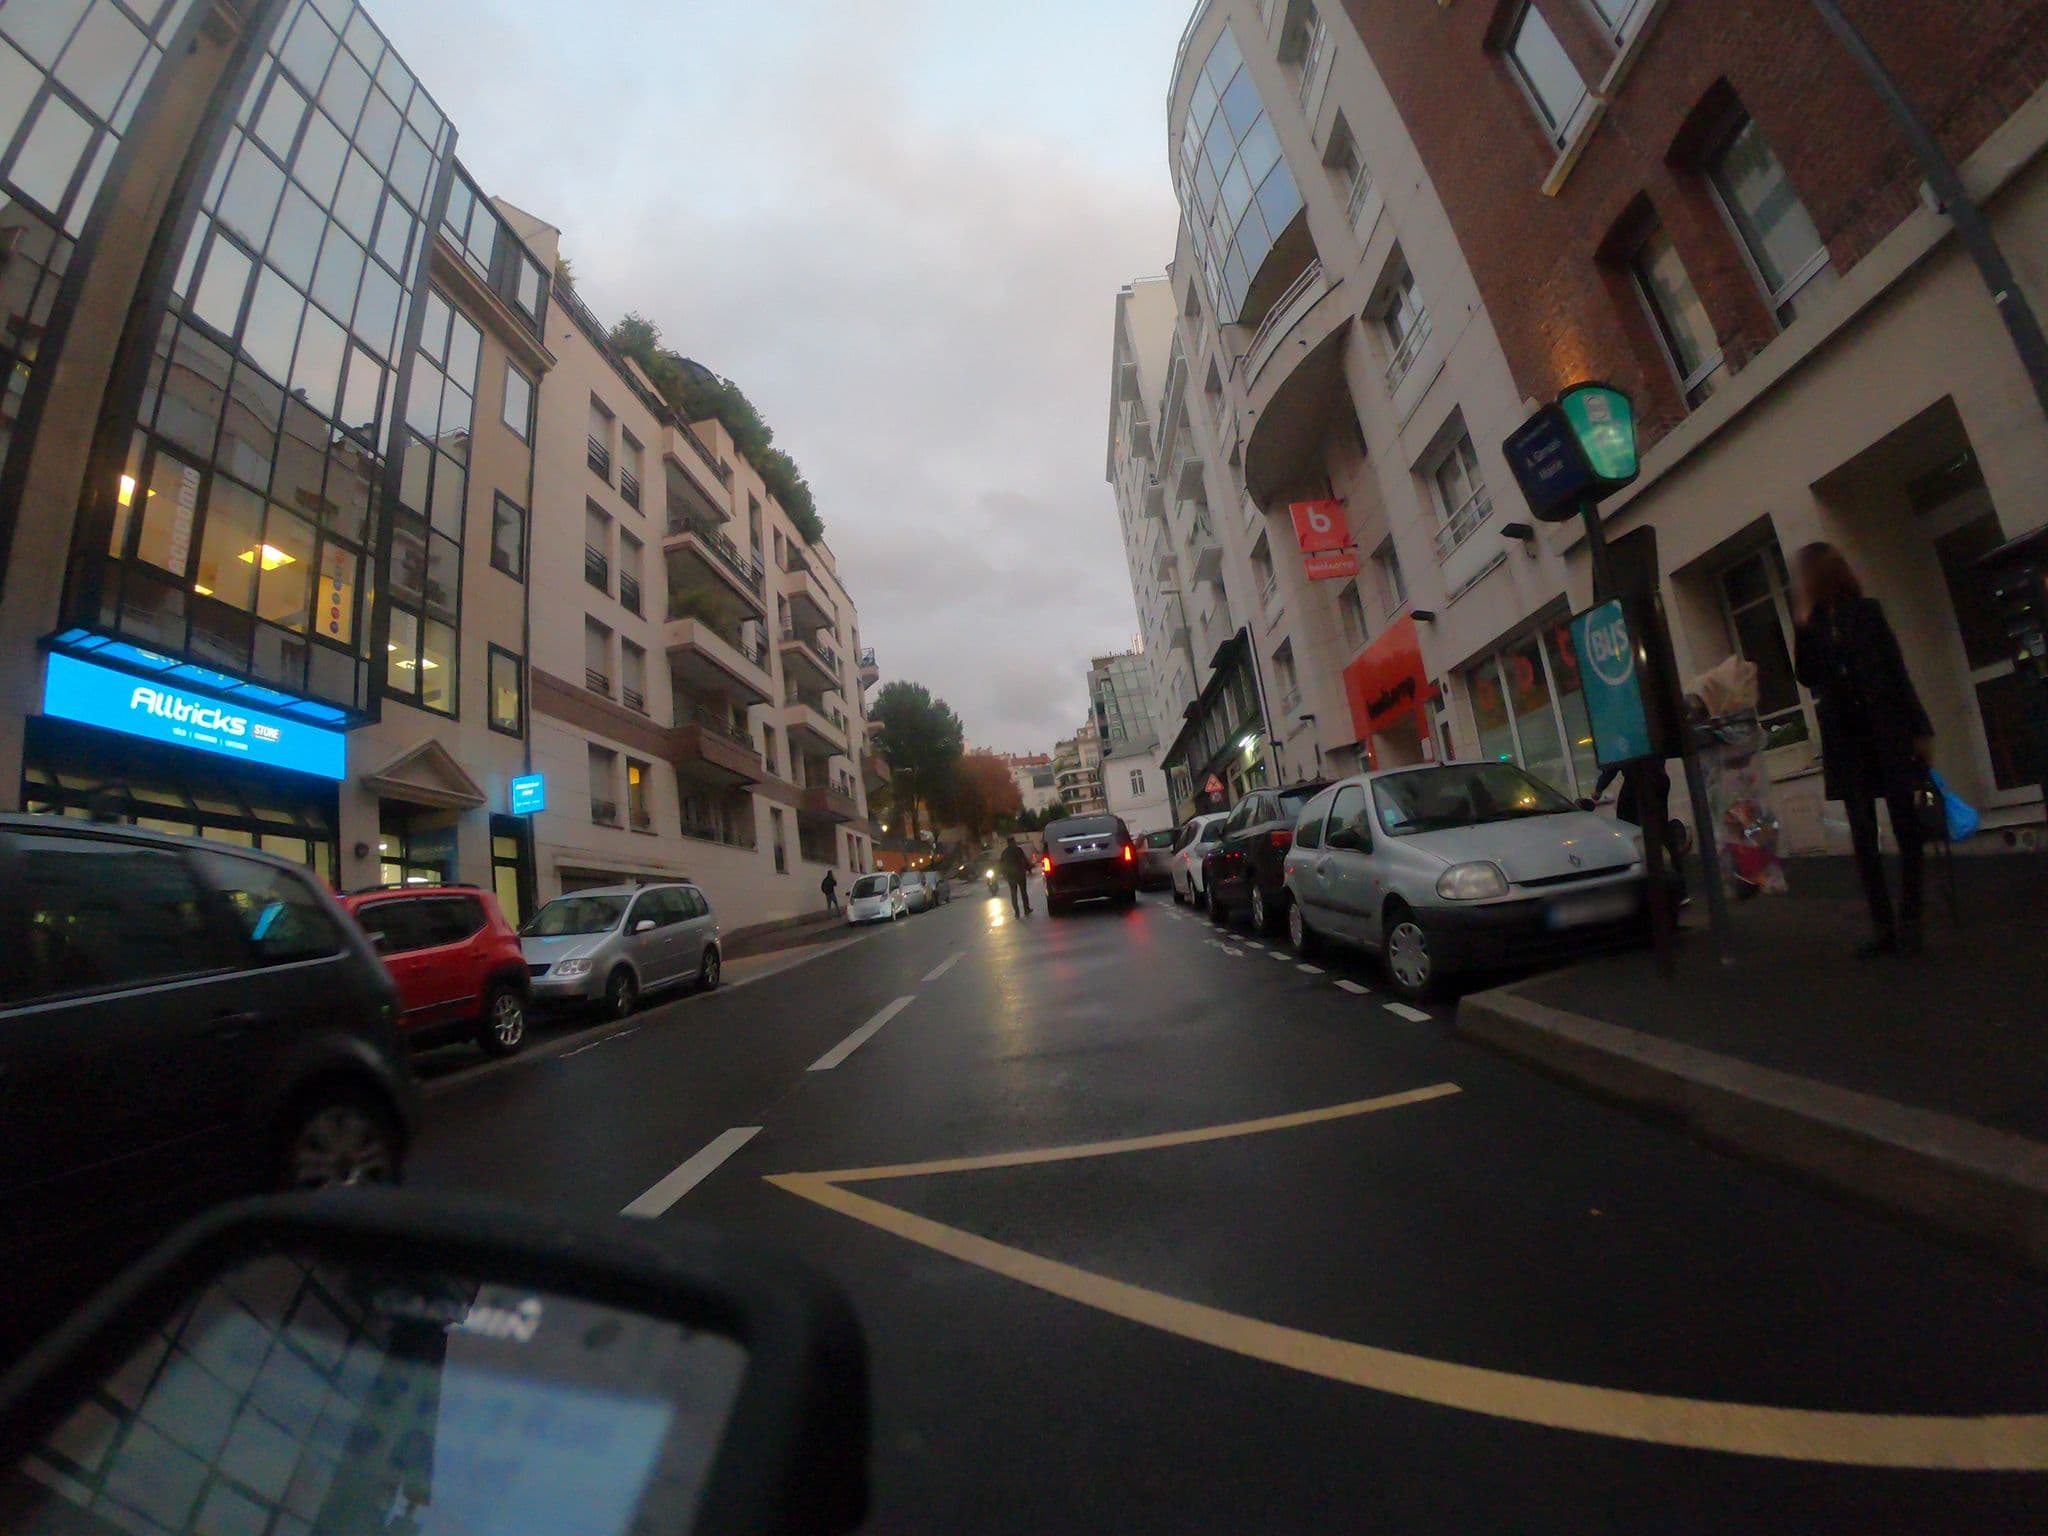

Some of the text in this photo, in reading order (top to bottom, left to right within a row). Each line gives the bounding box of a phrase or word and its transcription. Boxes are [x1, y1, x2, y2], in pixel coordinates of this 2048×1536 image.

[1307, 506, 1332, 533] b
[1592, 617, 1629, 662] BUS
[130, 686, 280, 742] Alltricks STORE
